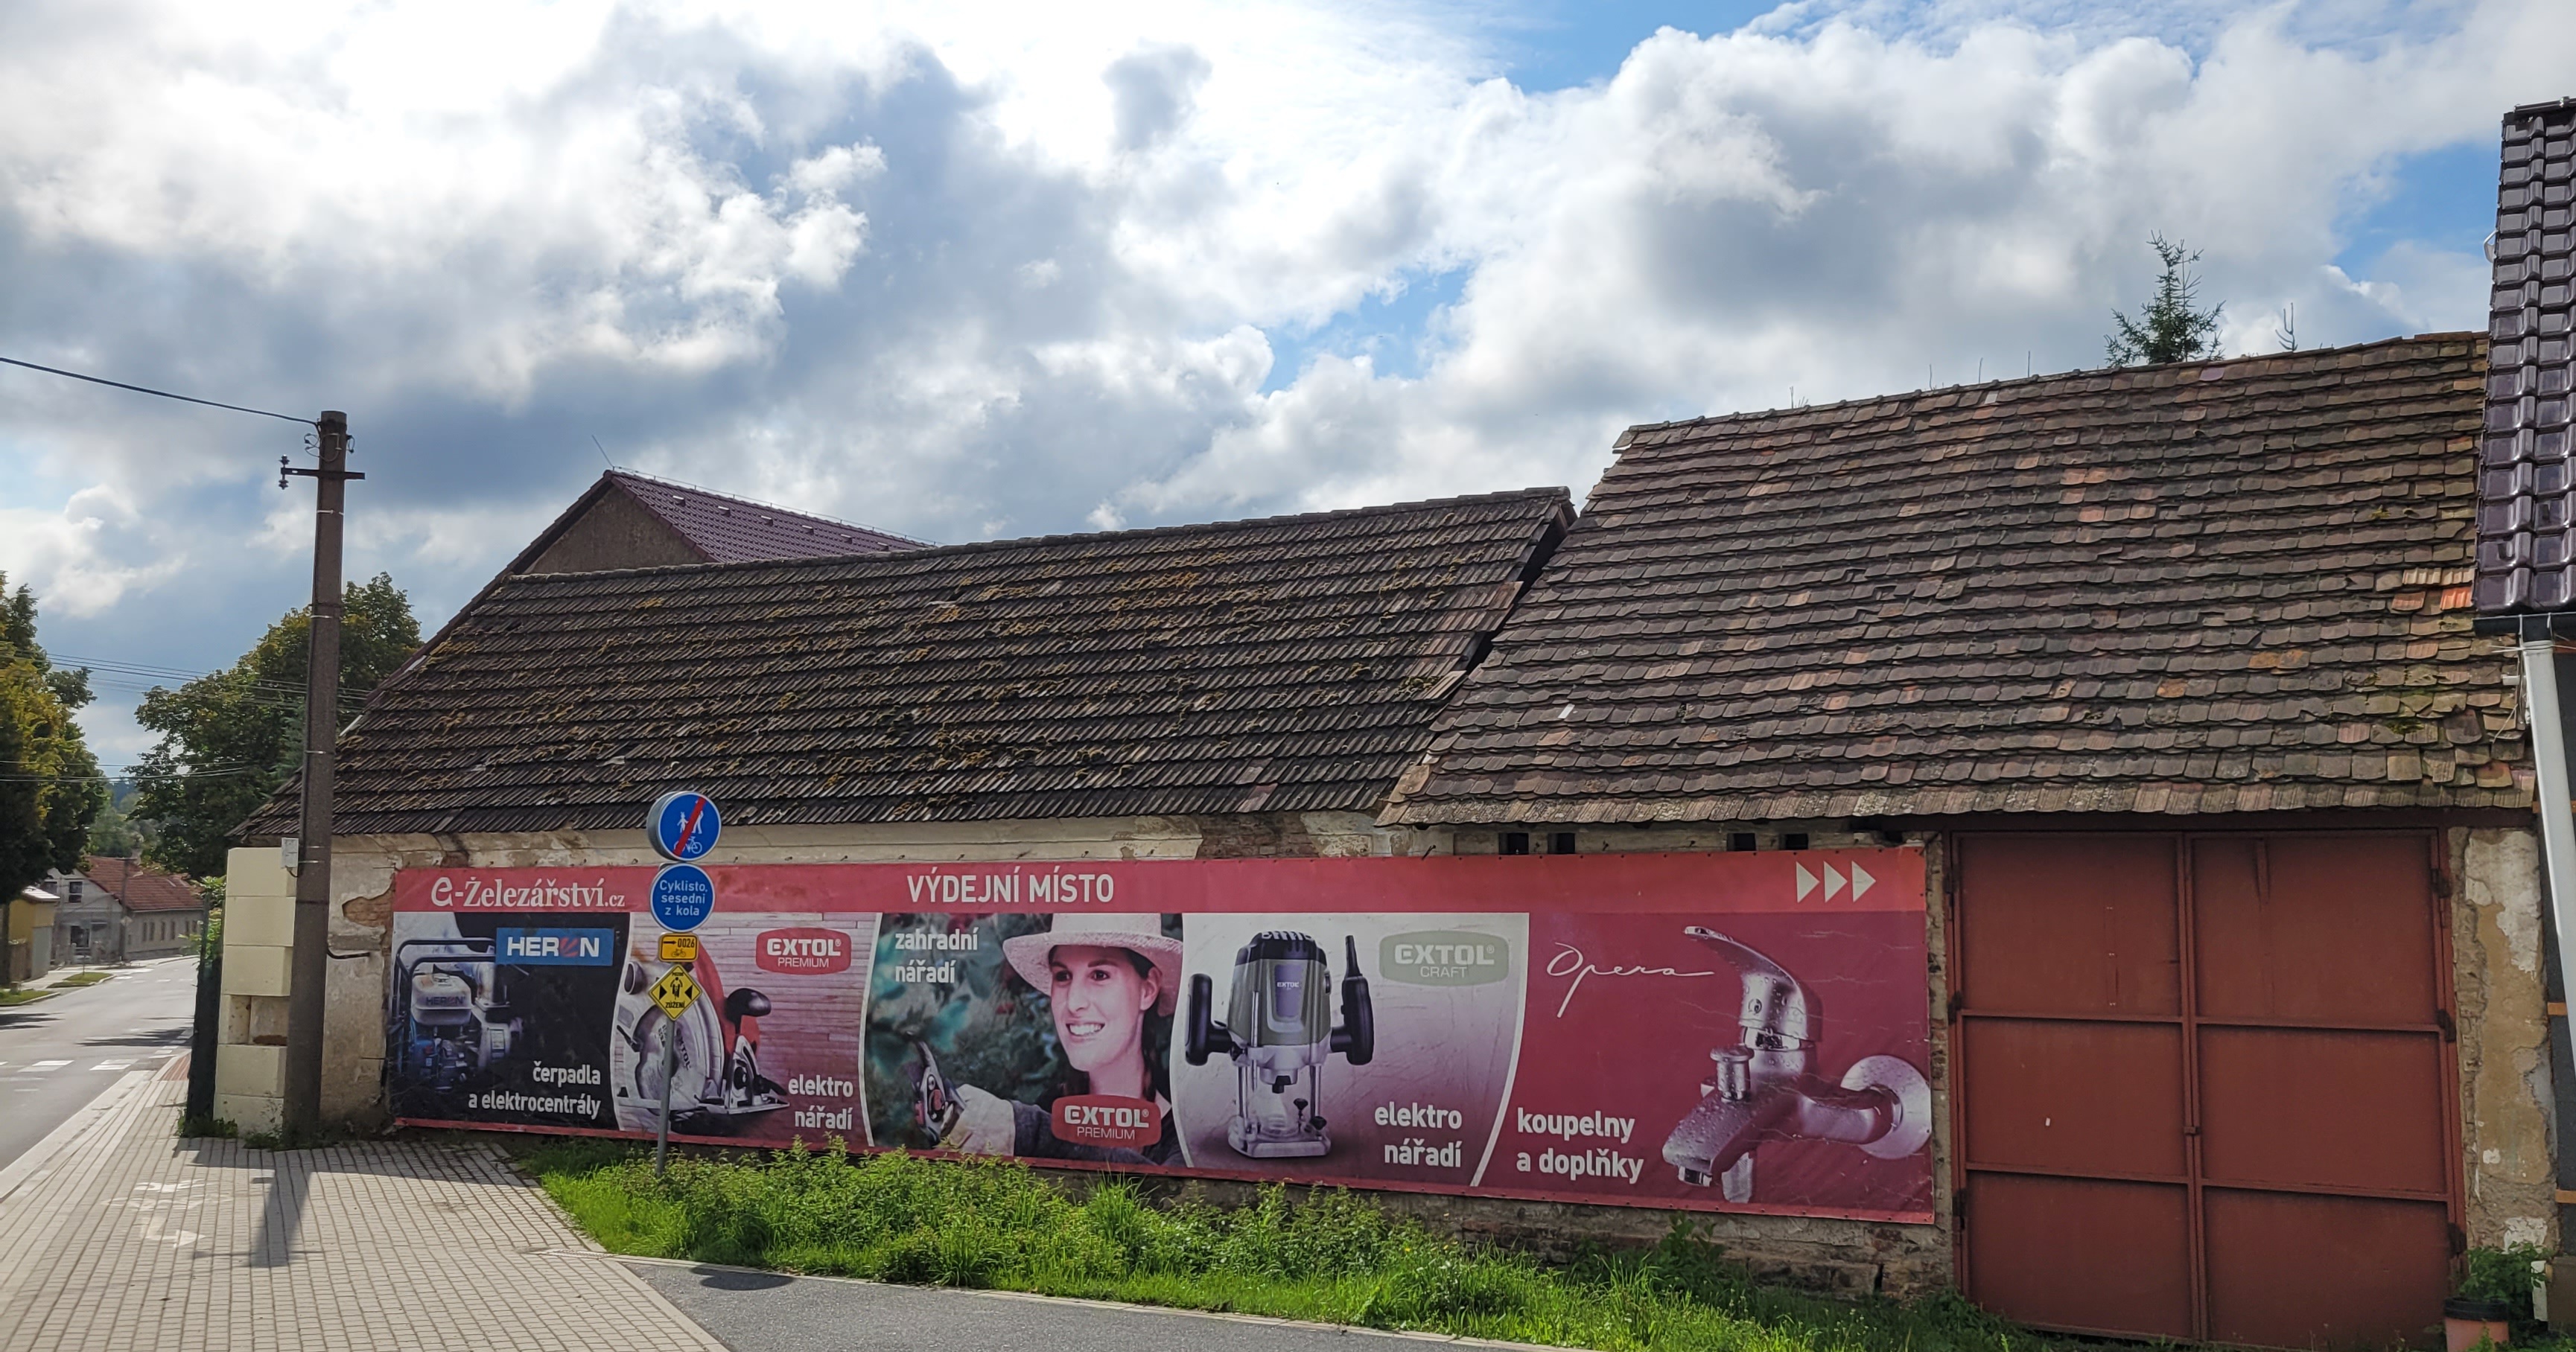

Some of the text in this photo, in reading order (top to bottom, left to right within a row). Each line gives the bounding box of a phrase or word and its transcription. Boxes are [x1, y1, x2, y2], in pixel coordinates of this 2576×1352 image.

[659, 879, 708, 893] Cyklisto,
[907, 866, 1114, 903] VÝDEJNÍ MÍSTO
[661, 893, 706, 905] sesedni
[664, 905, 700, 916] z kola
[677, 938, 695, 948] 0026
[895, 927, 979, 951] zahradní
[777, 957, 830, 968] PREMIUM
[895, 960, 957, 983] nářadí
[1419, 966, 1468, 978] CRAFT
[1547, 942, 1715, 1018] Opera
[532, 1061, 601, 1088] čerpadla
[788, 1074, 853, 1097] elektro
[468, 1090, 601, 1120] a elektrocentrály
[1374, 1101, 1463, 1129] elektro
[795, 1105, 853, 1130] nářadí
[1517, 1107, 1635, 1144] koupelny
[1077, 1126, 1135, 1140] PREMIUM
[1384, 1138, 1463, 1167] nářadí
[1516, 1147, 1644, 1184] a doplňky
